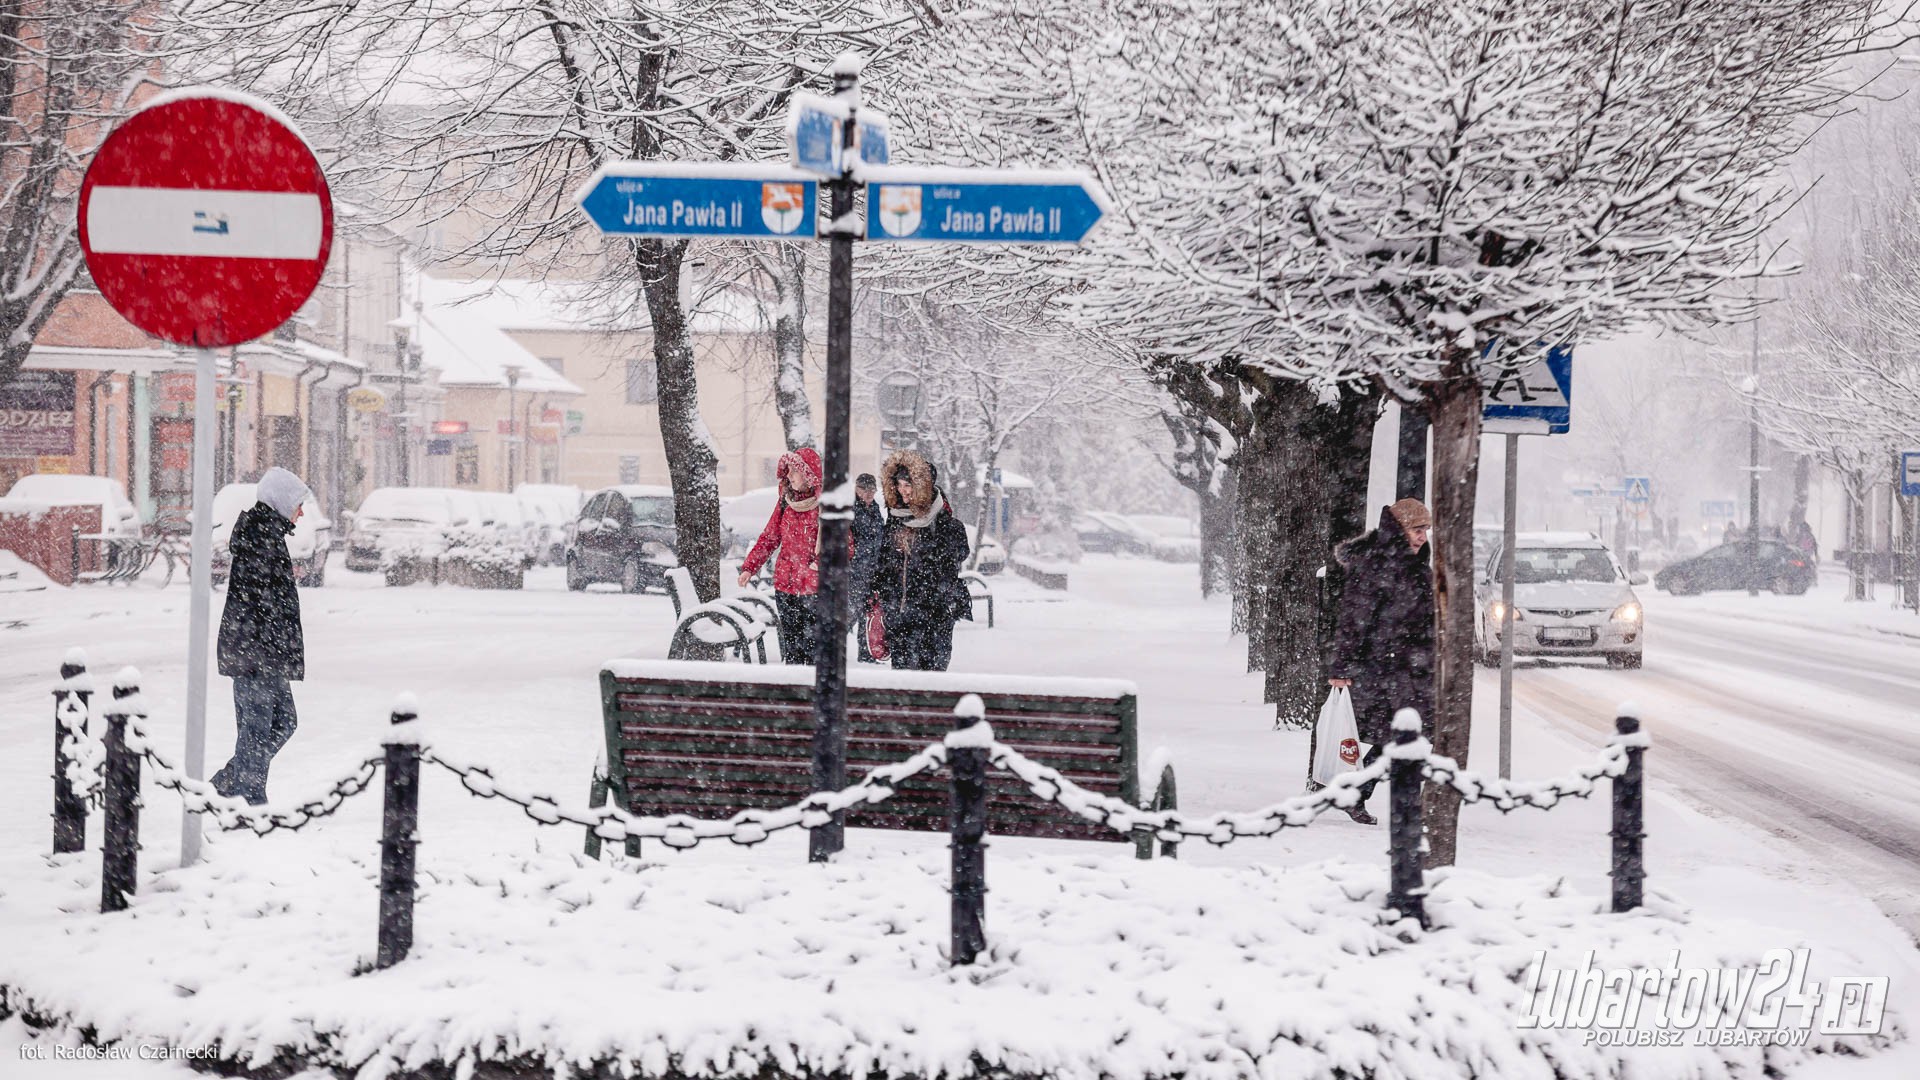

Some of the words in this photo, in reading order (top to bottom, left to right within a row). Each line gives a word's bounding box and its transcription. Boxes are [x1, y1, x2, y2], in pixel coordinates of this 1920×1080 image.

[616, 179, 643, 193] ulica
[933, 187, 961, 200] ulica
[623, 199, 668, 226] Jana
[672, 199, 726, 228] Pawła
[731, 199, 742, 228] II
[940, 205, 985, 232] Jana
[989, 205, 1045, 234] Pawła
[1049, 206, 1061, 234] II
